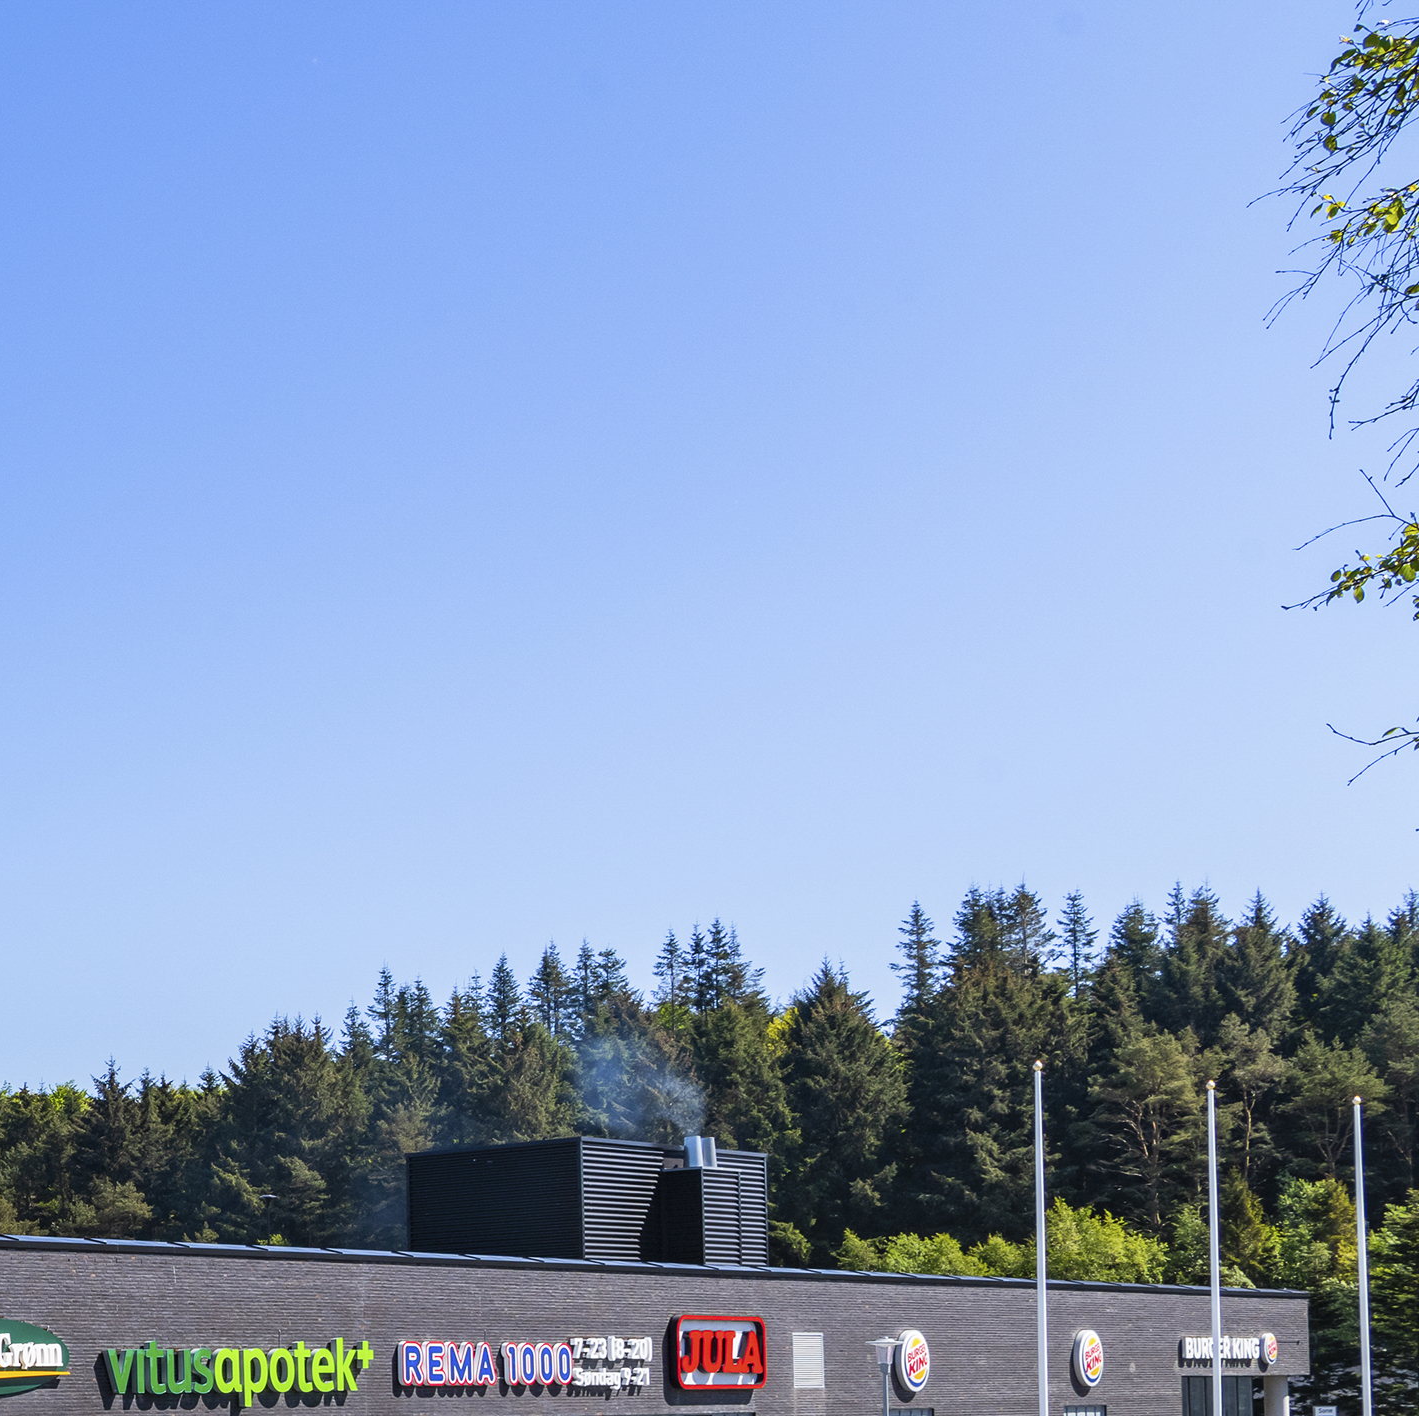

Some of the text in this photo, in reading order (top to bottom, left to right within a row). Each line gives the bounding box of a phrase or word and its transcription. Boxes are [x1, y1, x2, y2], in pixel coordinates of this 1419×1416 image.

[398, 1340, 574, 1387] REMA 1000
[682, 1329, 763, 1374] JULA
[1232, 1337, 1261, 1359] KING
